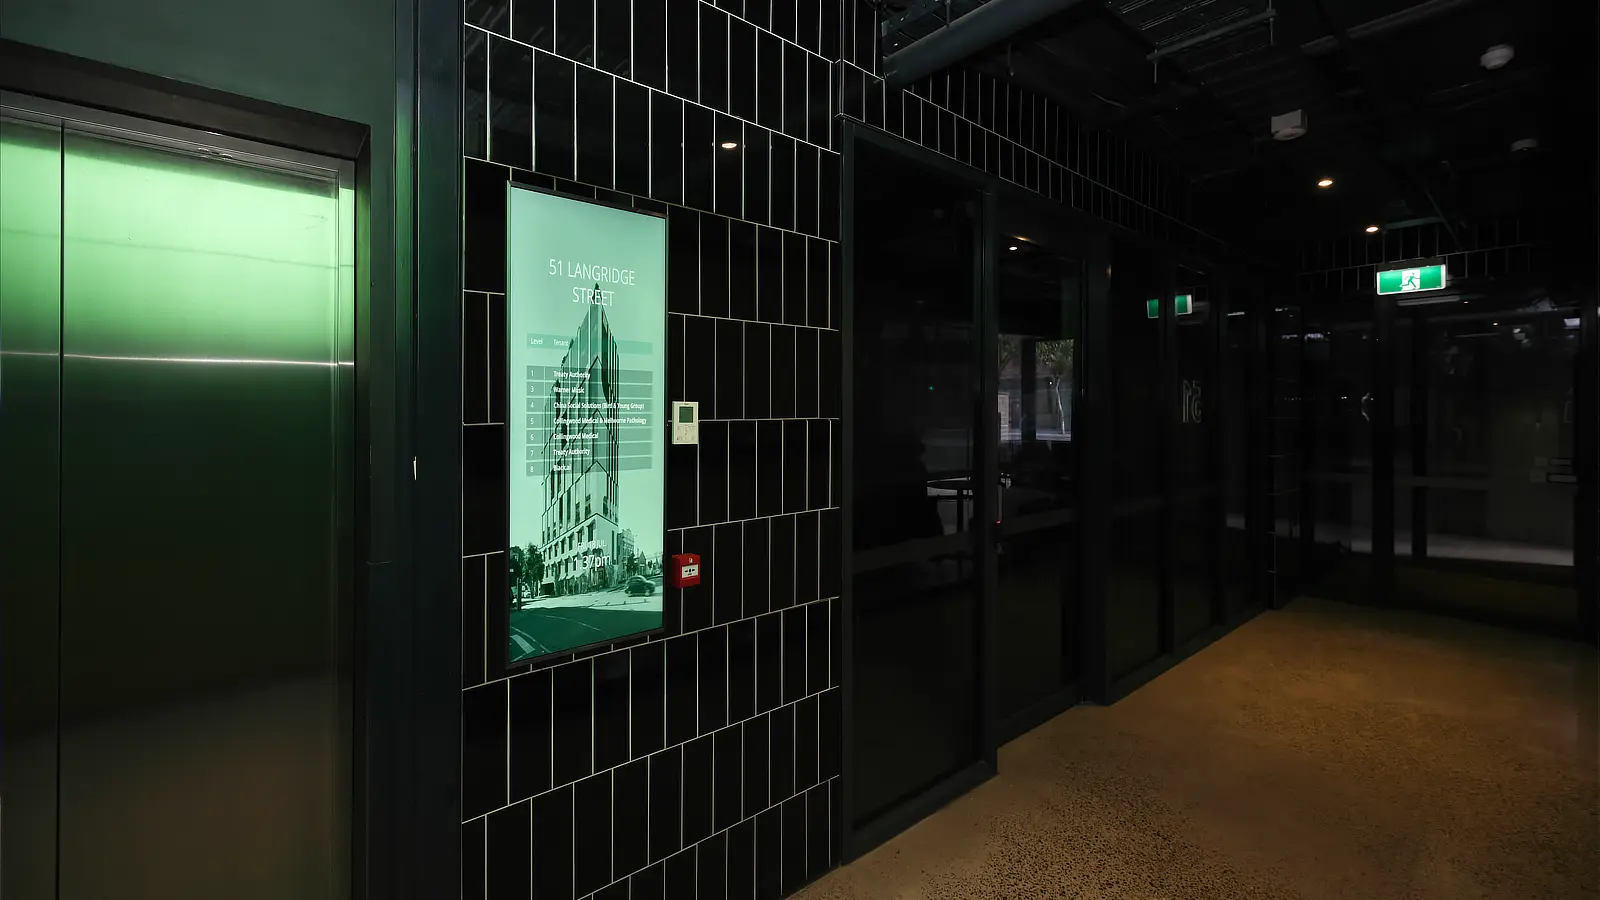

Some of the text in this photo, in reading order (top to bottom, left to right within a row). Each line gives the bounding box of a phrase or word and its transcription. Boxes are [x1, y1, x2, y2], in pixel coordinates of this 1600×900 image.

[549, 258, 636, 286] 51 LANGRIDGE
[572, 286, 615, 307] STREET
[530, 337, 543, 345] Level
[553, 370, 569, 379] Treaty
[568, 371, 591, 379] Authority
[572, 386, 585, 394] Music
[630, 402, 645, 410] Group)
[530, 417, 534, 425] 5
[553, 417, 581, 425] Collingwood
[626, 417, 647, 425] Pathology
[530, 432, 599, 441] 6 Collingwood Medical
[530, 448, 591, 457] 7 Treaty Authority
[530, 465, 534, 473] 8
